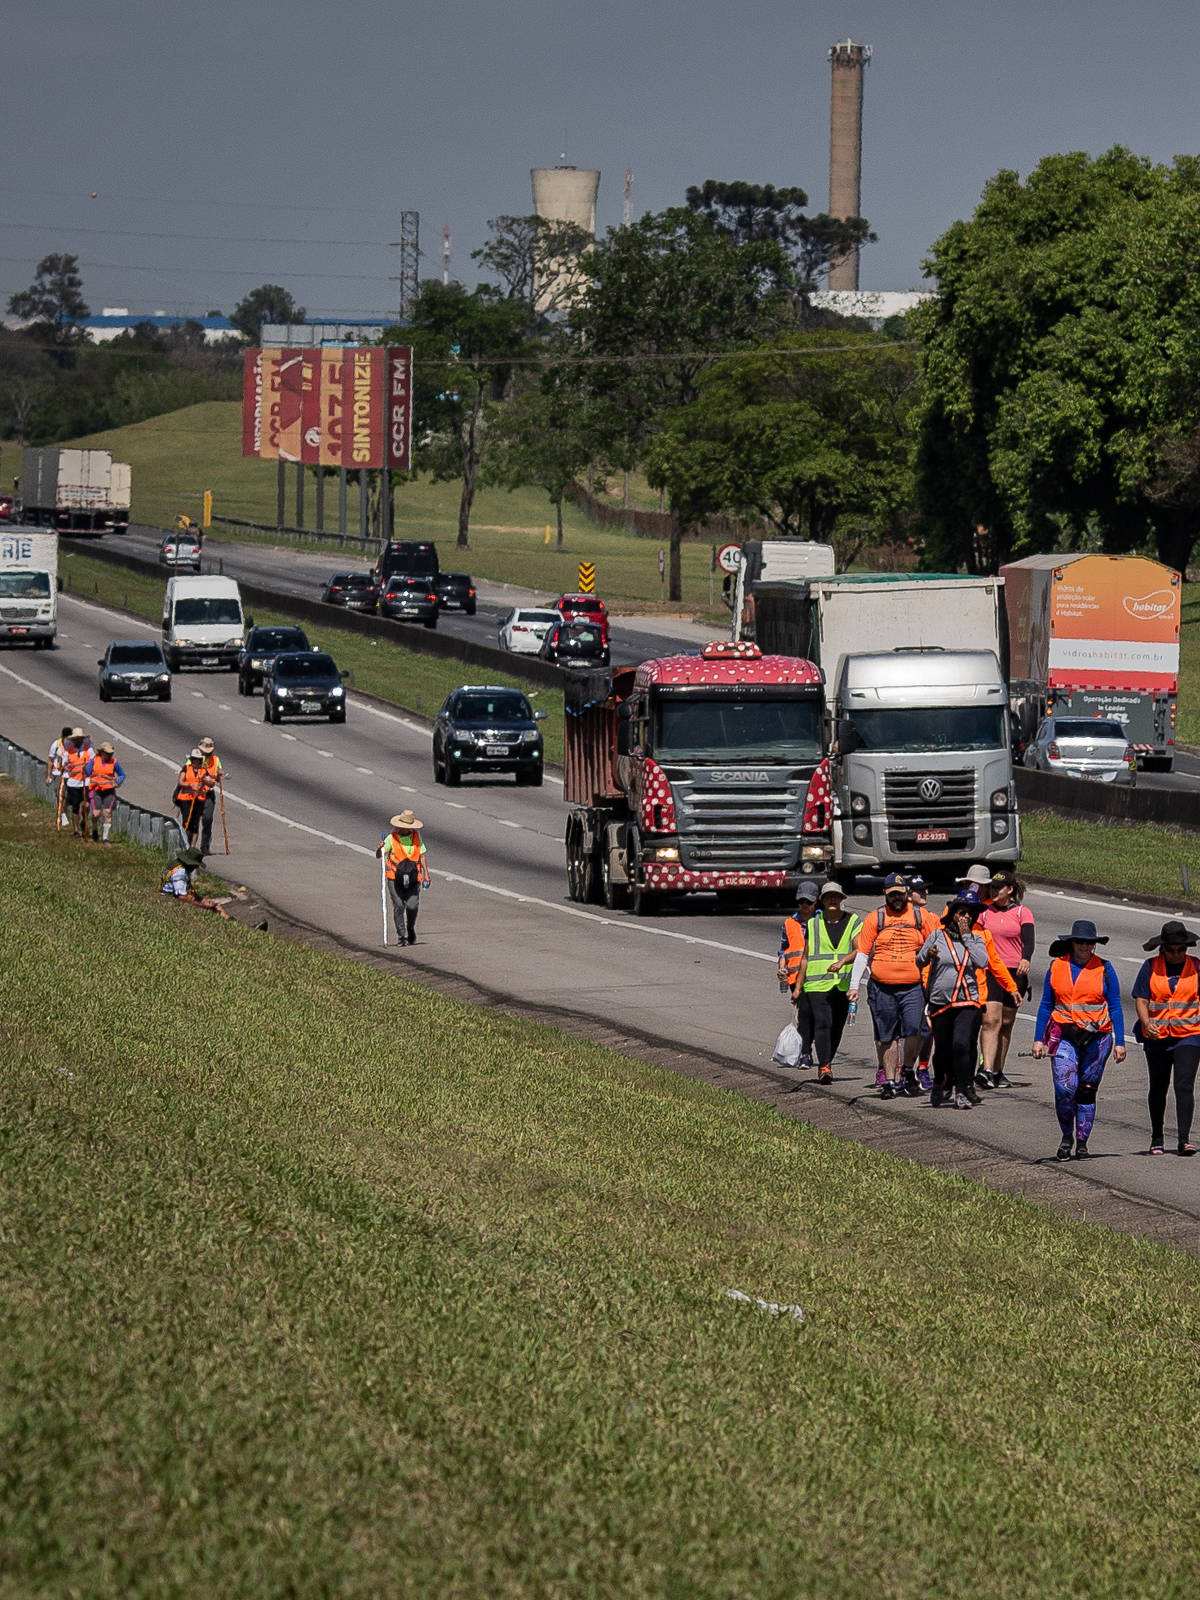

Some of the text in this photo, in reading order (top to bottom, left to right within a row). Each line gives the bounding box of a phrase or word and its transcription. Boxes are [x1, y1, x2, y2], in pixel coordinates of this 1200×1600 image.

[352, 352, 371, 463] SINTONIZE
[392, 359, 406, 458] CCR FM
[722, 550, 741, 563] 40
[711, 772, 770, 782] SCANIA
